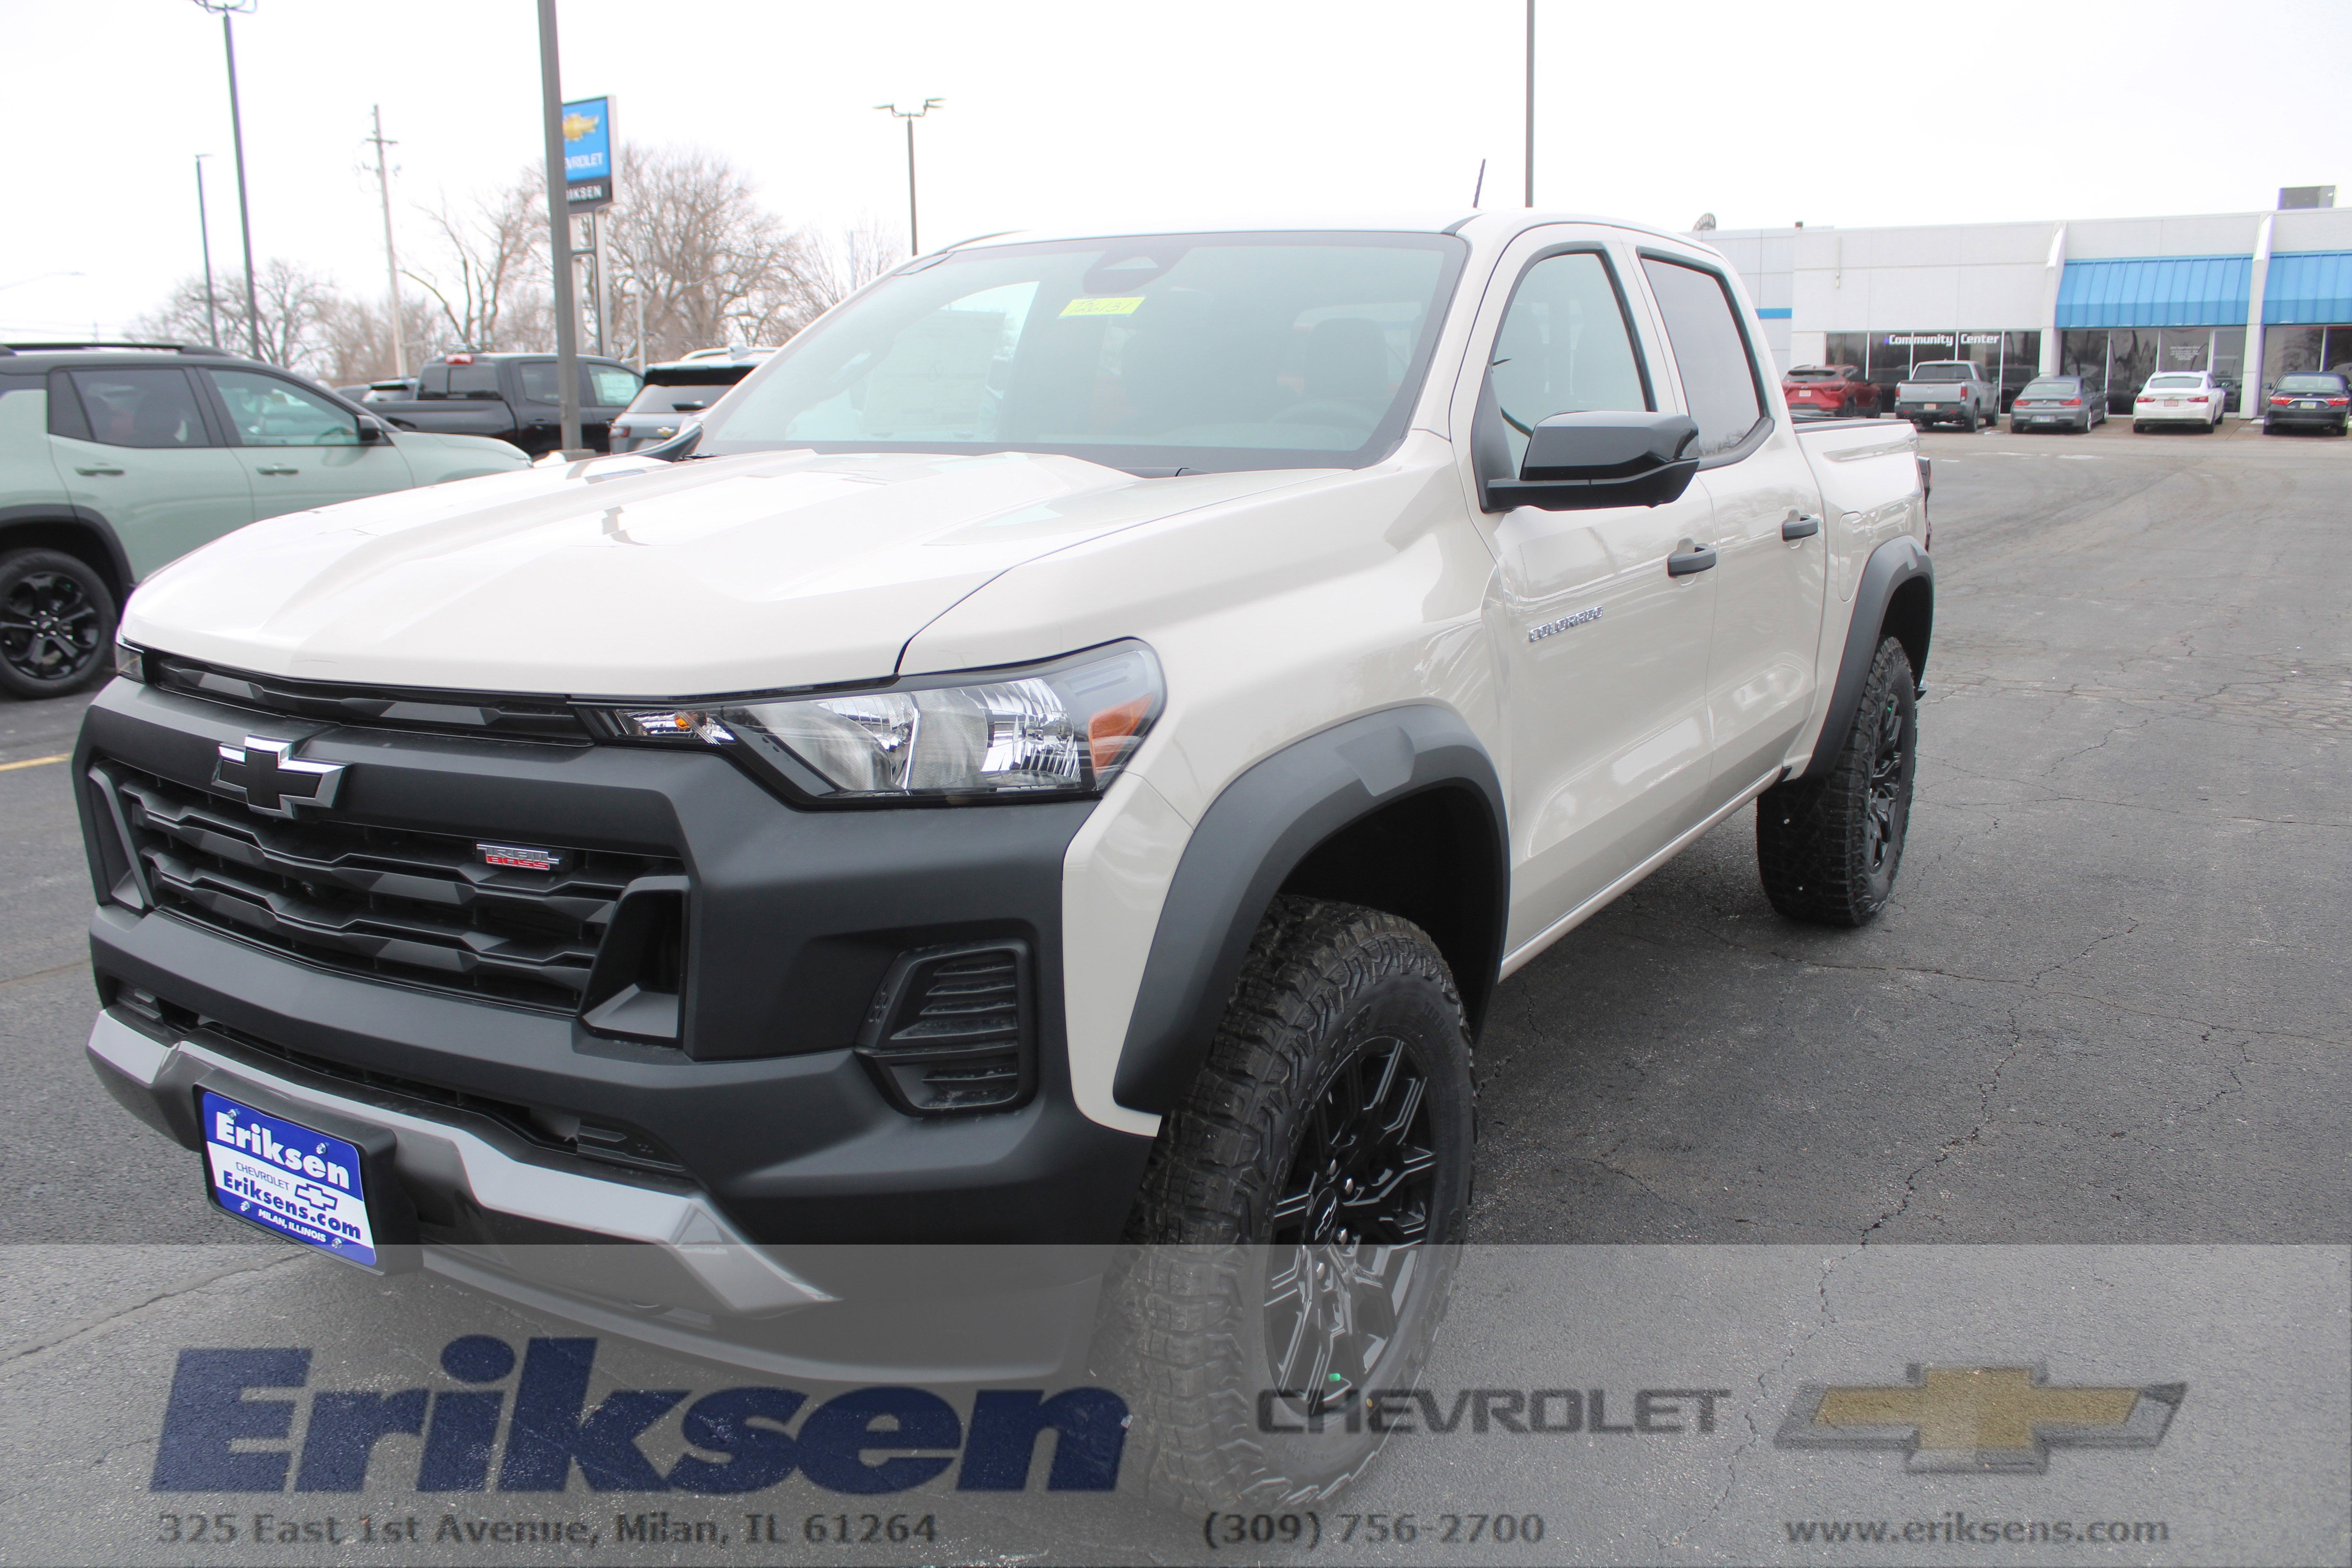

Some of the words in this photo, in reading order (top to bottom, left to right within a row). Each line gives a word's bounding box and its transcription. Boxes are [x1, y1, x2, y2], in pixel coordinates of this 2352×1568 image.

[564, 152, 603, 169] VROLET
[1889, 334, 1953, 347] Community
[1960, 333, 2000, 344] Center
[1529, 605, 1603, 642] COLORADO
[476, 844, 559, 864] TRAIL
[486, 855, 550, 871] BOSS
[216, 1111, 350, 1189] Eriksen
[236, 1161, 290, 1191] CHEVROLET
[223, 1170, 361, 1240] Eriksens.com
[258, 1208, 287, 1229] MILAN,
[288, 1222, 326, 1243] ILLINOIS
